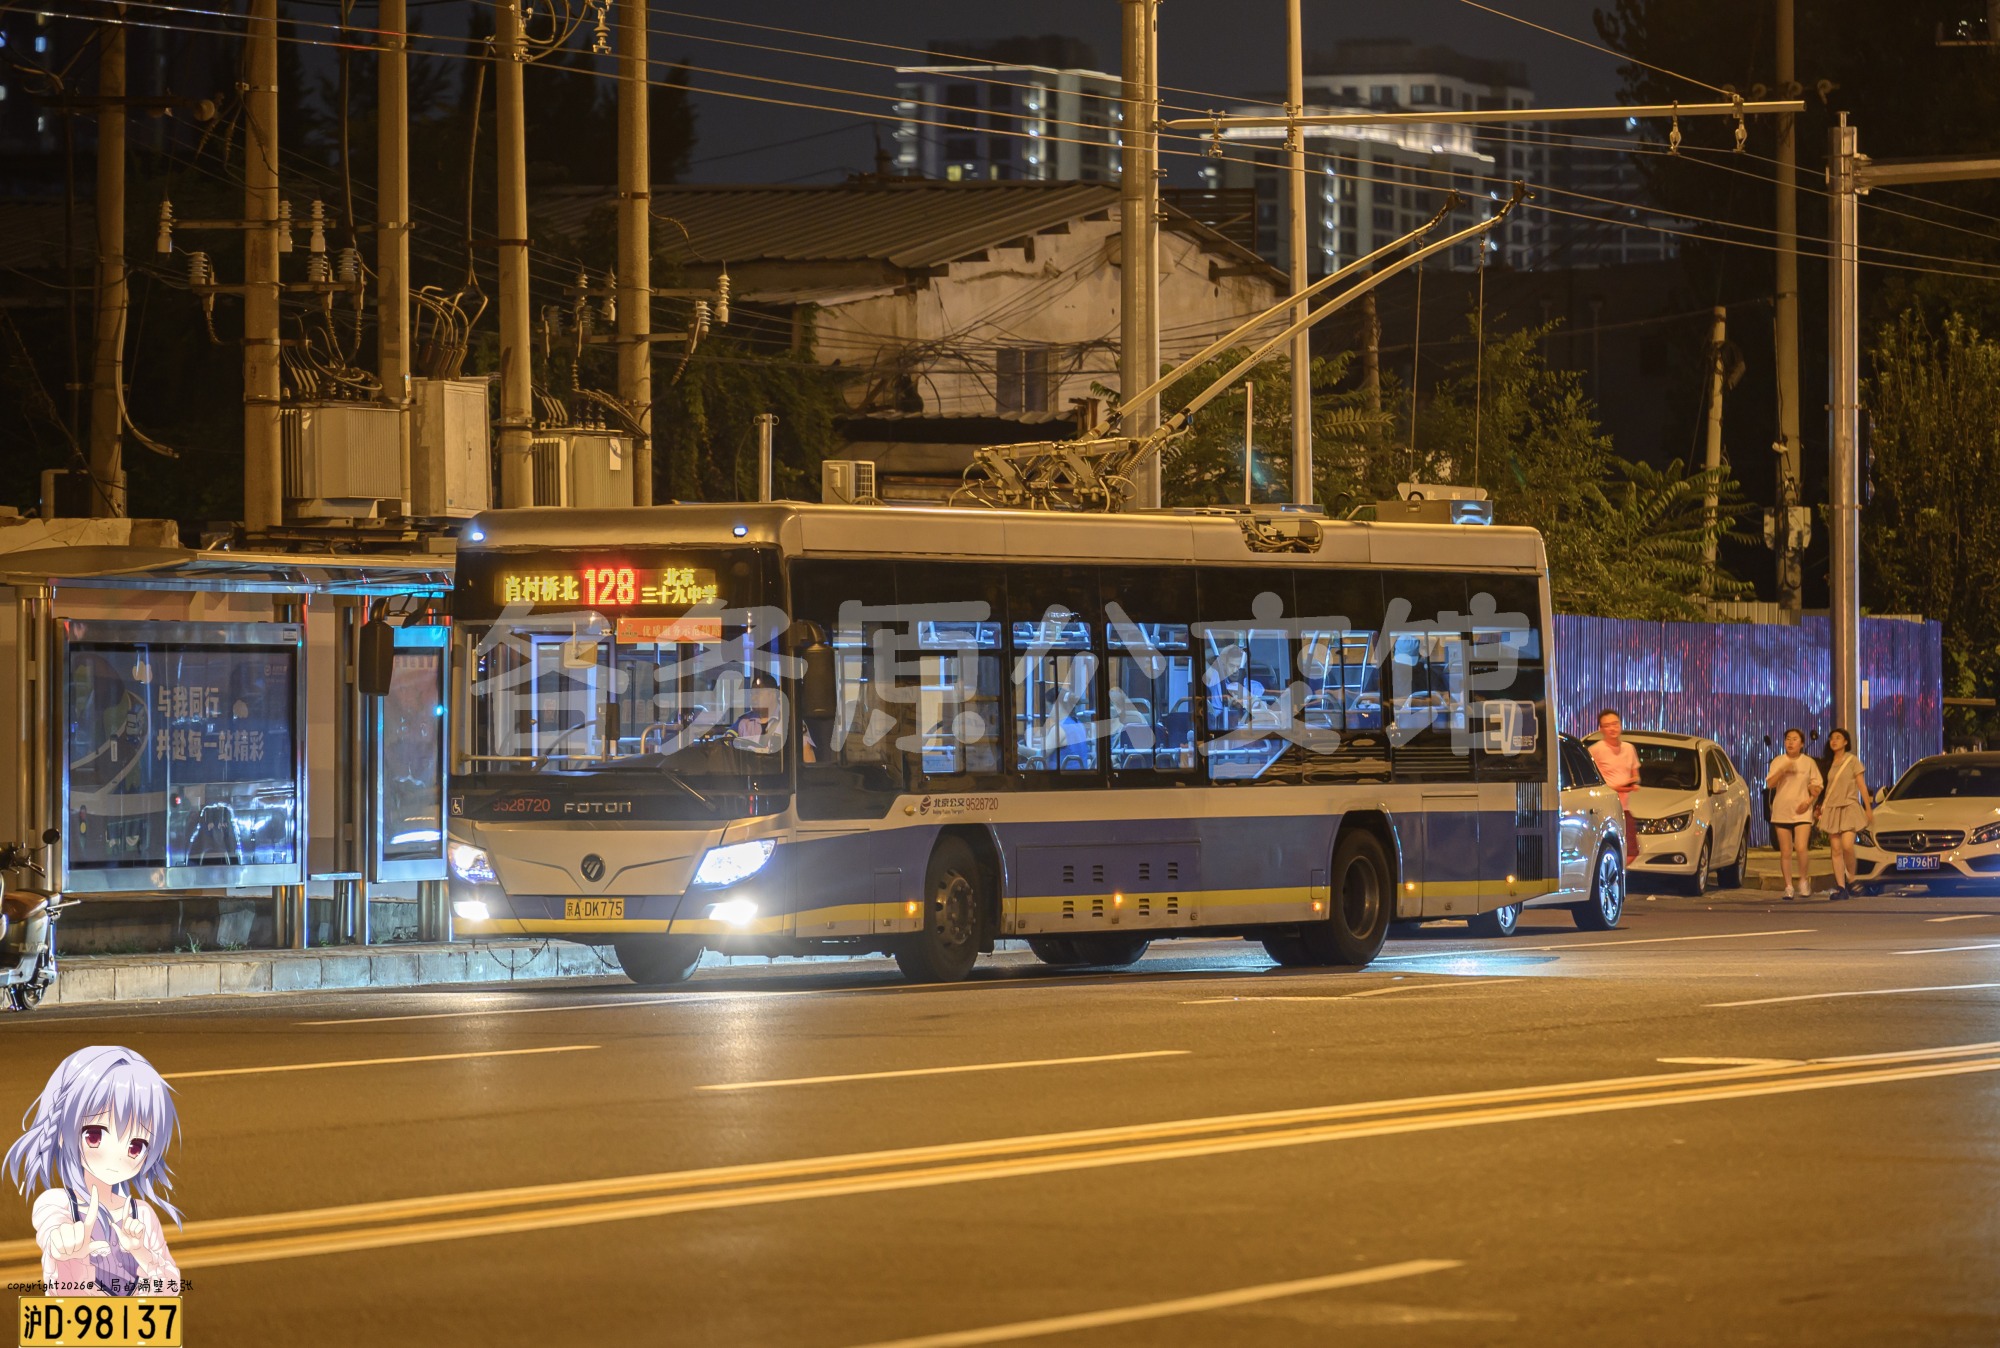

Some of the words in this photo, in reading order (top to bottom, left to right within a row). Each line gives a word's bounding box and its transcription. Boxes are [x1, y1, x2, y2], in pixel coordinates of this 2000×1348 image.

[505, 576, 579, 601] 肖村桥北
[585, 568, 634, 605] 128
[664, 568, 695, 587] 北京
[641, 585, 718, 604] 三十九中学
[158, 686, 219, 718] 与我同行
[157, 729, 264, 762] 共赴每一站精彩
[933, 798, 965, 808] 北京公交
[966, 798, 998, 811] 9528720
